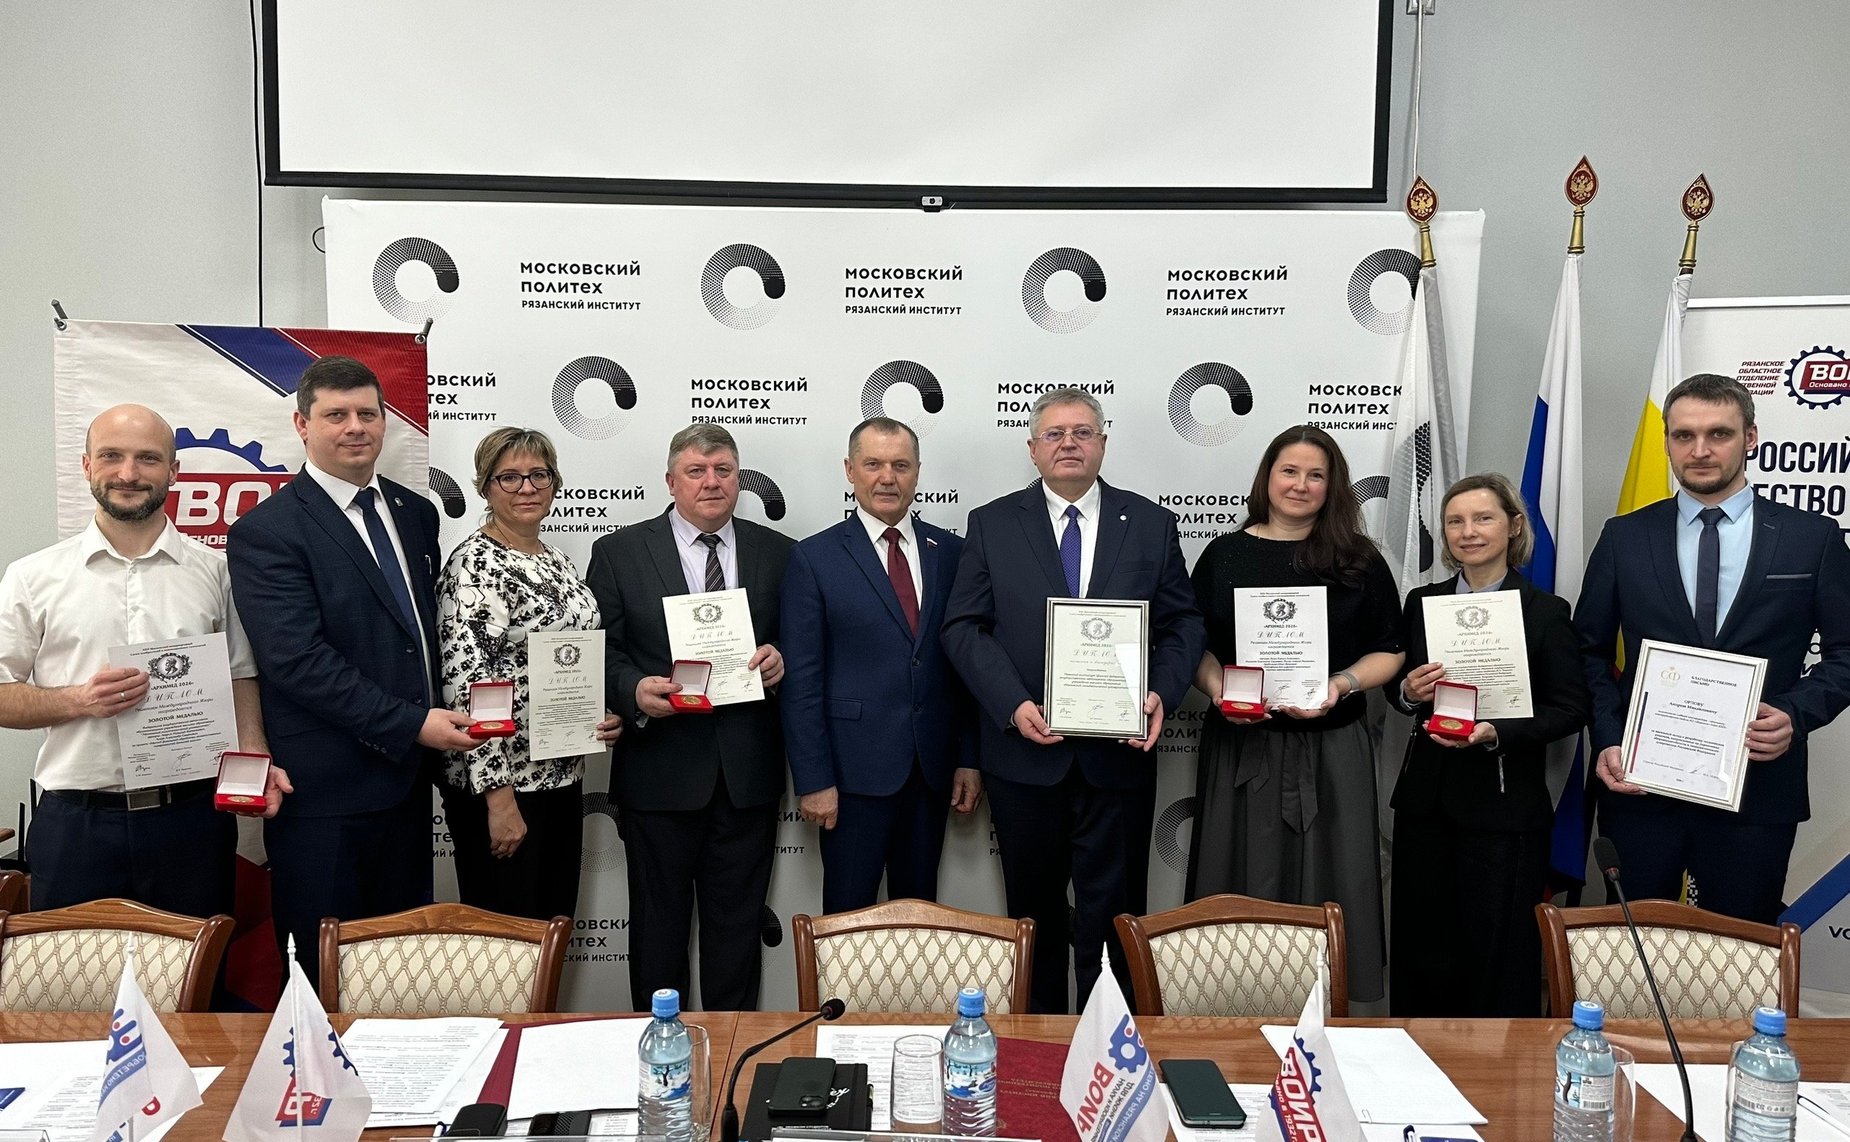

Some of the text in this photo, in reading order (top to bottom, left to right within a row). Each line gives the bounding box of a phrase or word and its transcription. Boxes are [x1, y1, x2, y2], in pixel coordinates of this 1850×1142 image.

[522, 300, 640, 310] РЯЗАНСКИЙ ИНСТИТУТ
[846, 304, 962, 314] РЯЗАНСКИЙ ИНСТИТУТ
[1167, 306, 1285, 316] РЯЗАНСКИЙ ИНСТИТУТ
[1809, 364, 1850, 381] ВО
[443, 412, 496, 421] ИНСТИТУТ
[691, 415, 807, 426] РЯЗАНСКИЙ ИНСТИТУТ
[997, 420, 1029, 428] РЯЗАН
[541, 523, 589, 533] ЗАНСКИЙ
[1177, 530, 1218, 538] АНСКИЙ
